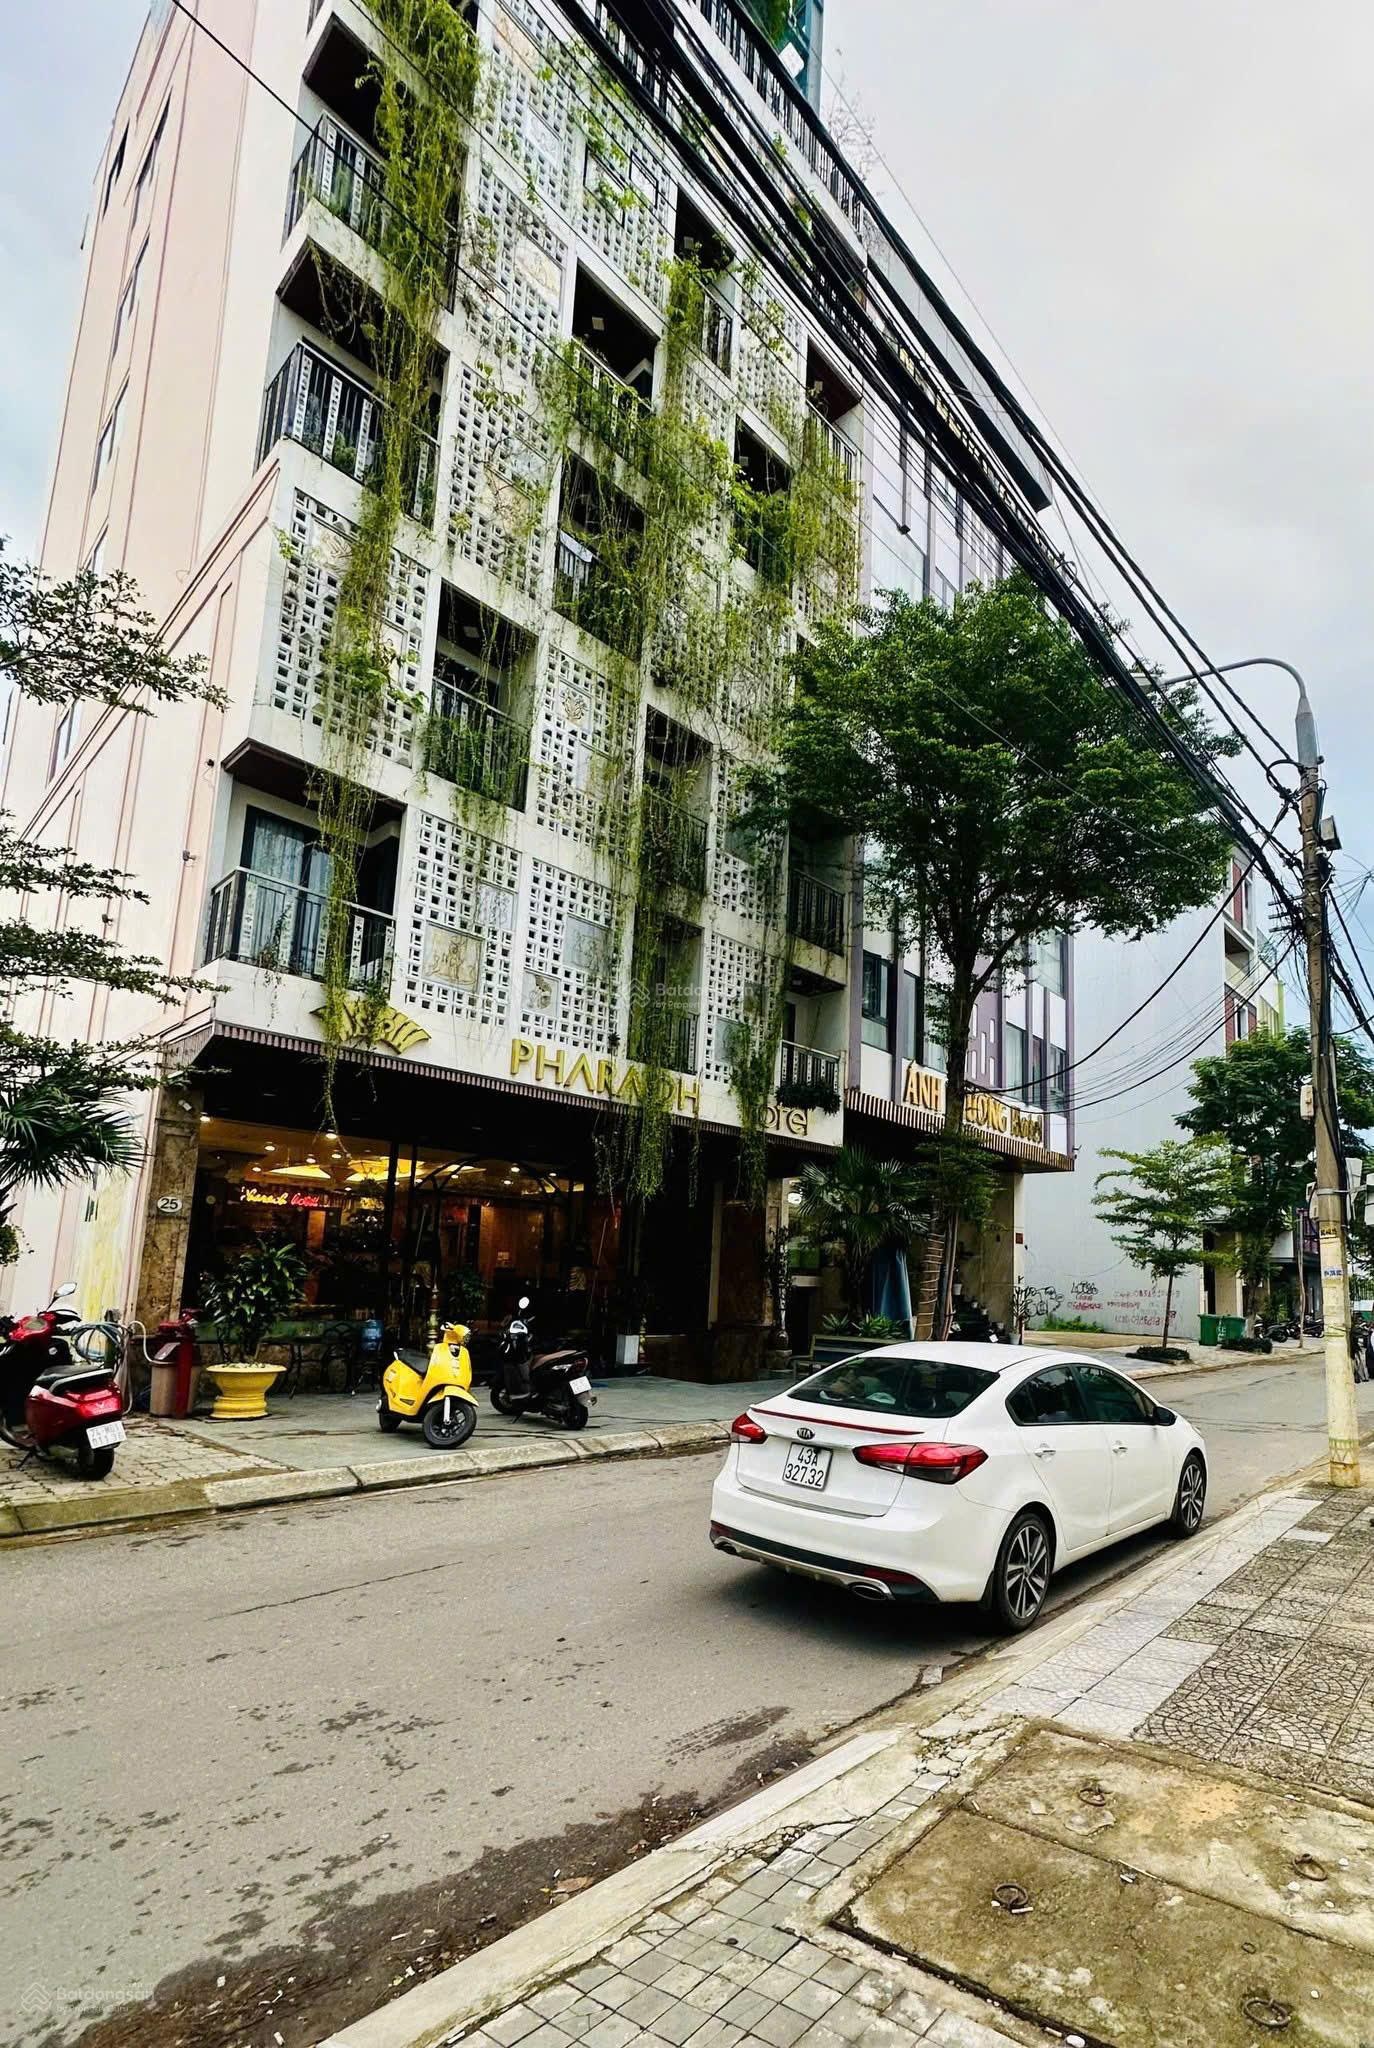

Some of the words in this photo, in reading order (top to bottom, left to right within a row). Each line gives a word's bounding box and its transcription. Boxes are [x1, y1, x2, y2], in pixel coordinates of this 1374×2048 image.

[751, 1100, 817, 1137] otel
[160, 1197, 178, 1209] 25
[798, 1429, 811, 1438] KIA
[797, 1447, 818, 1466] 43A
[785, 1463, 824, 1486] 327.32
